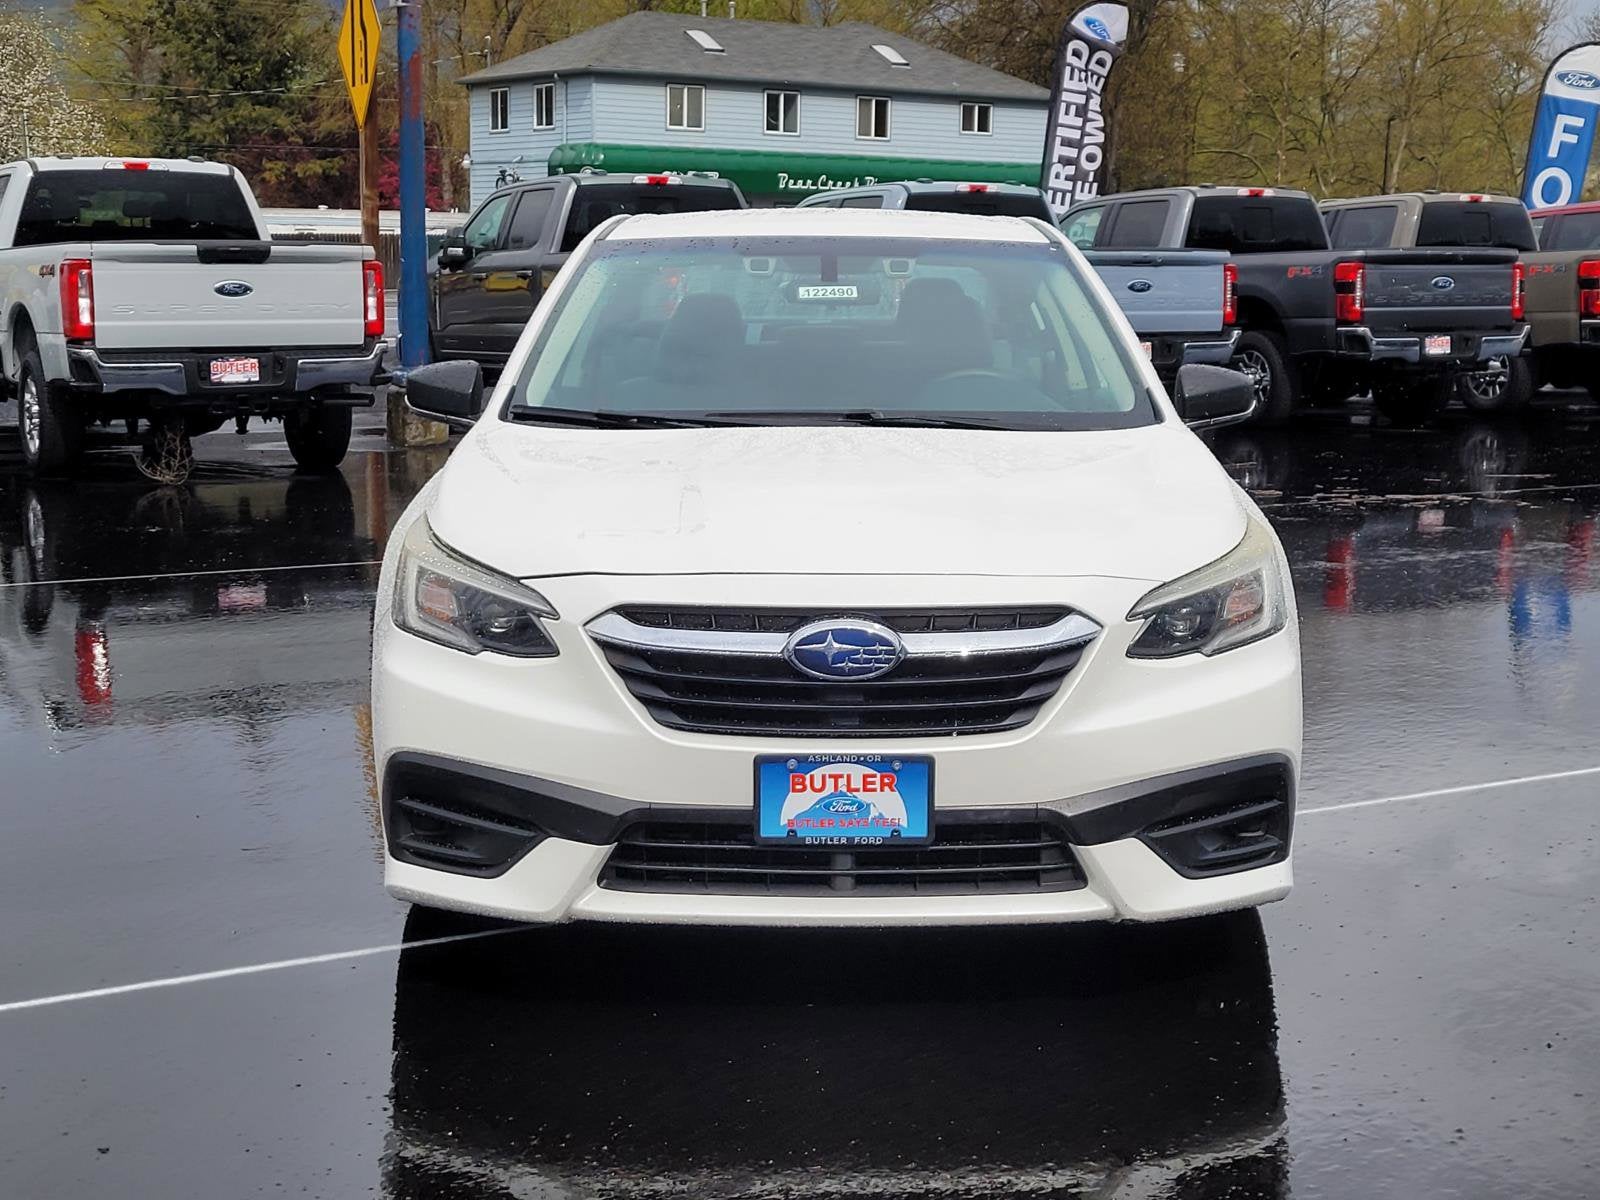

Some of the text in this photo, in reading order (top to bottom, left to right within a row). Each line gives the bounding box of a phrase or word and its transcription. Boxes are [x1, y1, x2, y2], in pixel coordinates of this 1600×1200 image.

[1564, 73, 1596, 88] Ford
[778, 173, 817, 188] Bear
[818, 175, 860, 189] Creek
[212, 362, 257, 373] BUTLER
[790, 773, 898, 793] BUTLER
[787, 817, 900, 828] BUTLER SAYS YES!
[805, 836, 883, 845] BUTLER FORD
